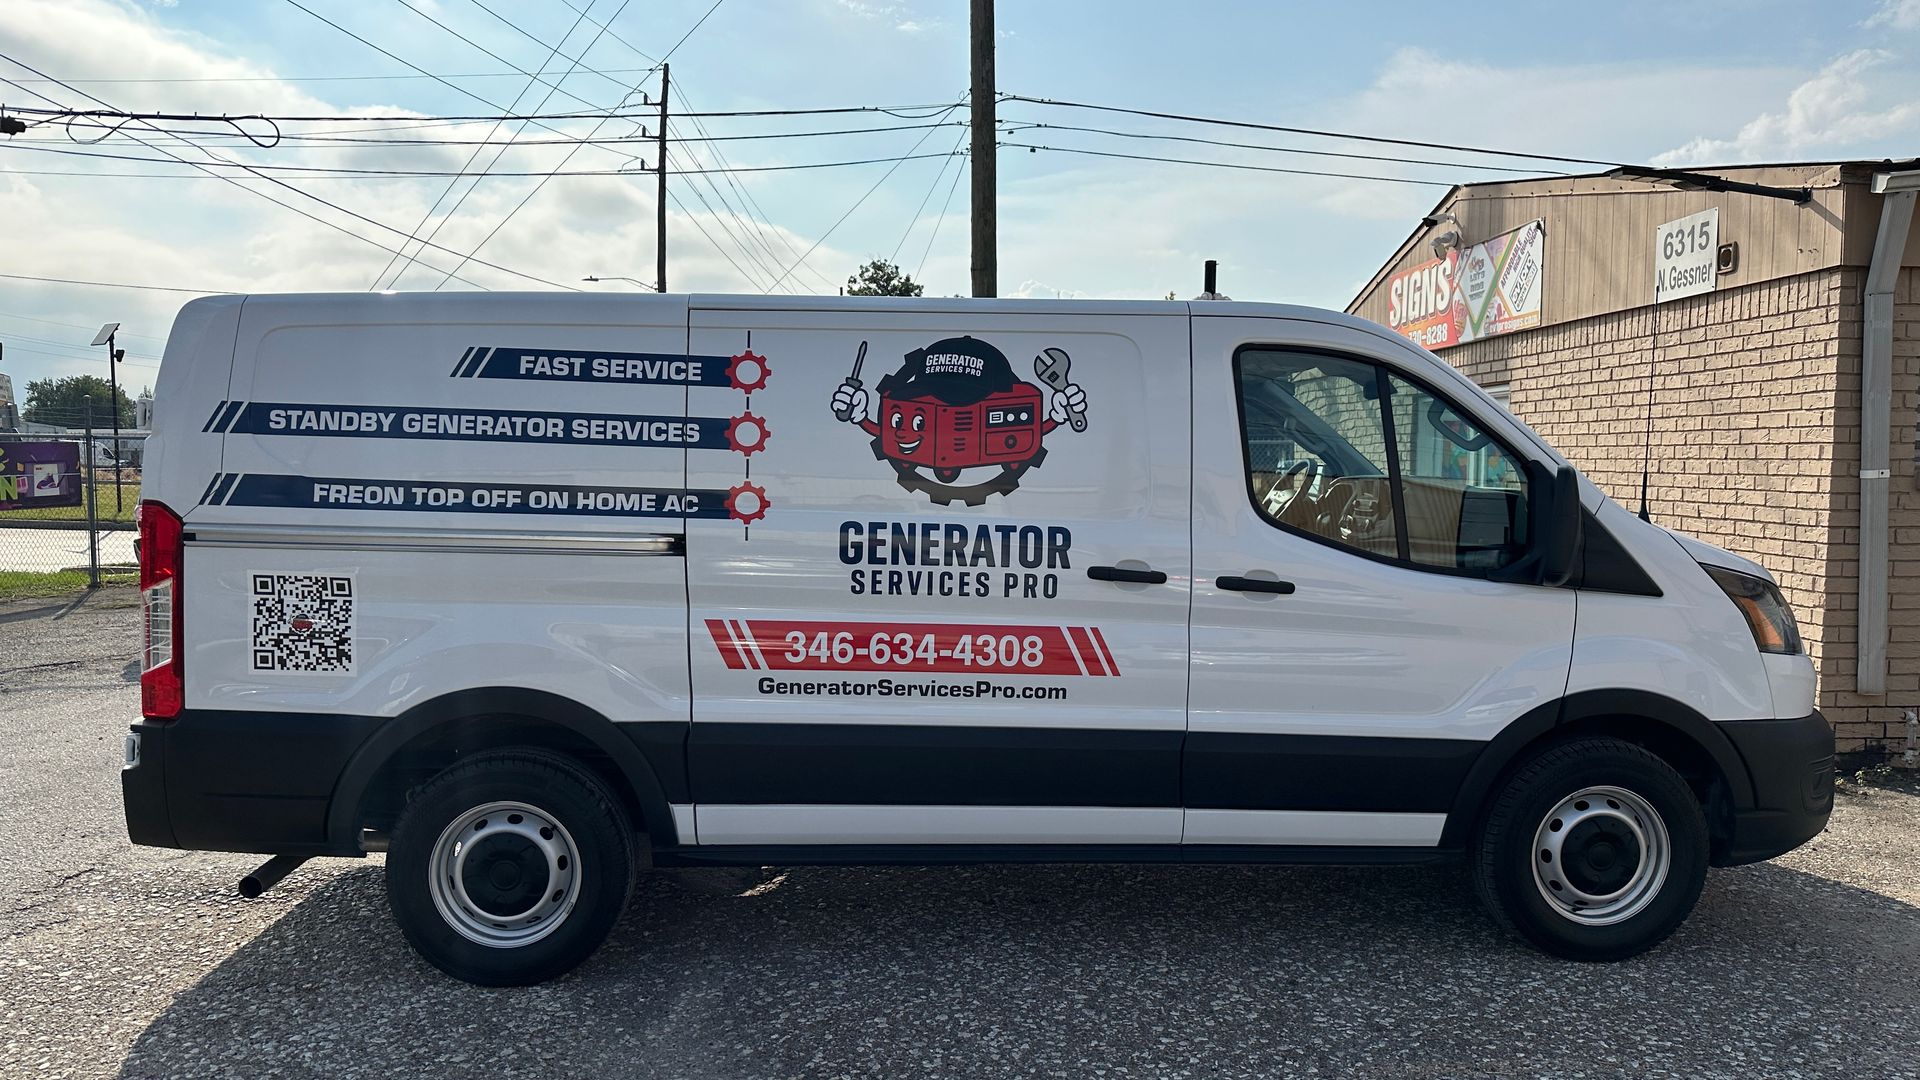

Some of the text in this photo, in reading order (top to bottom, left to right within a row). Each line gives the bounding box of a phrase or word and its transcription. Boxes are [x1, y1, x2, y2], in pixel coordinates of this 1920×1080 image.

[1663, 221, 1710, 260] 6315
[1500, 239, 1523, 288] AFFORDABLE
[1669, 262, 1712, 290] Gessner
[1390, 257, 1453, 328] SIGNS
[519, 354, 702, 382] FAST SERVICE
[925, 365, 982, 377] SERVICES PRO
[926, 353, 984, 370] GENERATOR
[269, 409, 700, 443] STANDBY GENERATOR SERVICES
[313, 483, 700, 514] FREON TOP OFF ON HOME AC
[839, 521, 1072, 569] GENERATOR
[850, 570, 1059, 599] SERVICES PRO
[784, 631, 1044, 667] 346-634-4308
[758, 677, 1068, 700] GeneratorServicesPro.com
